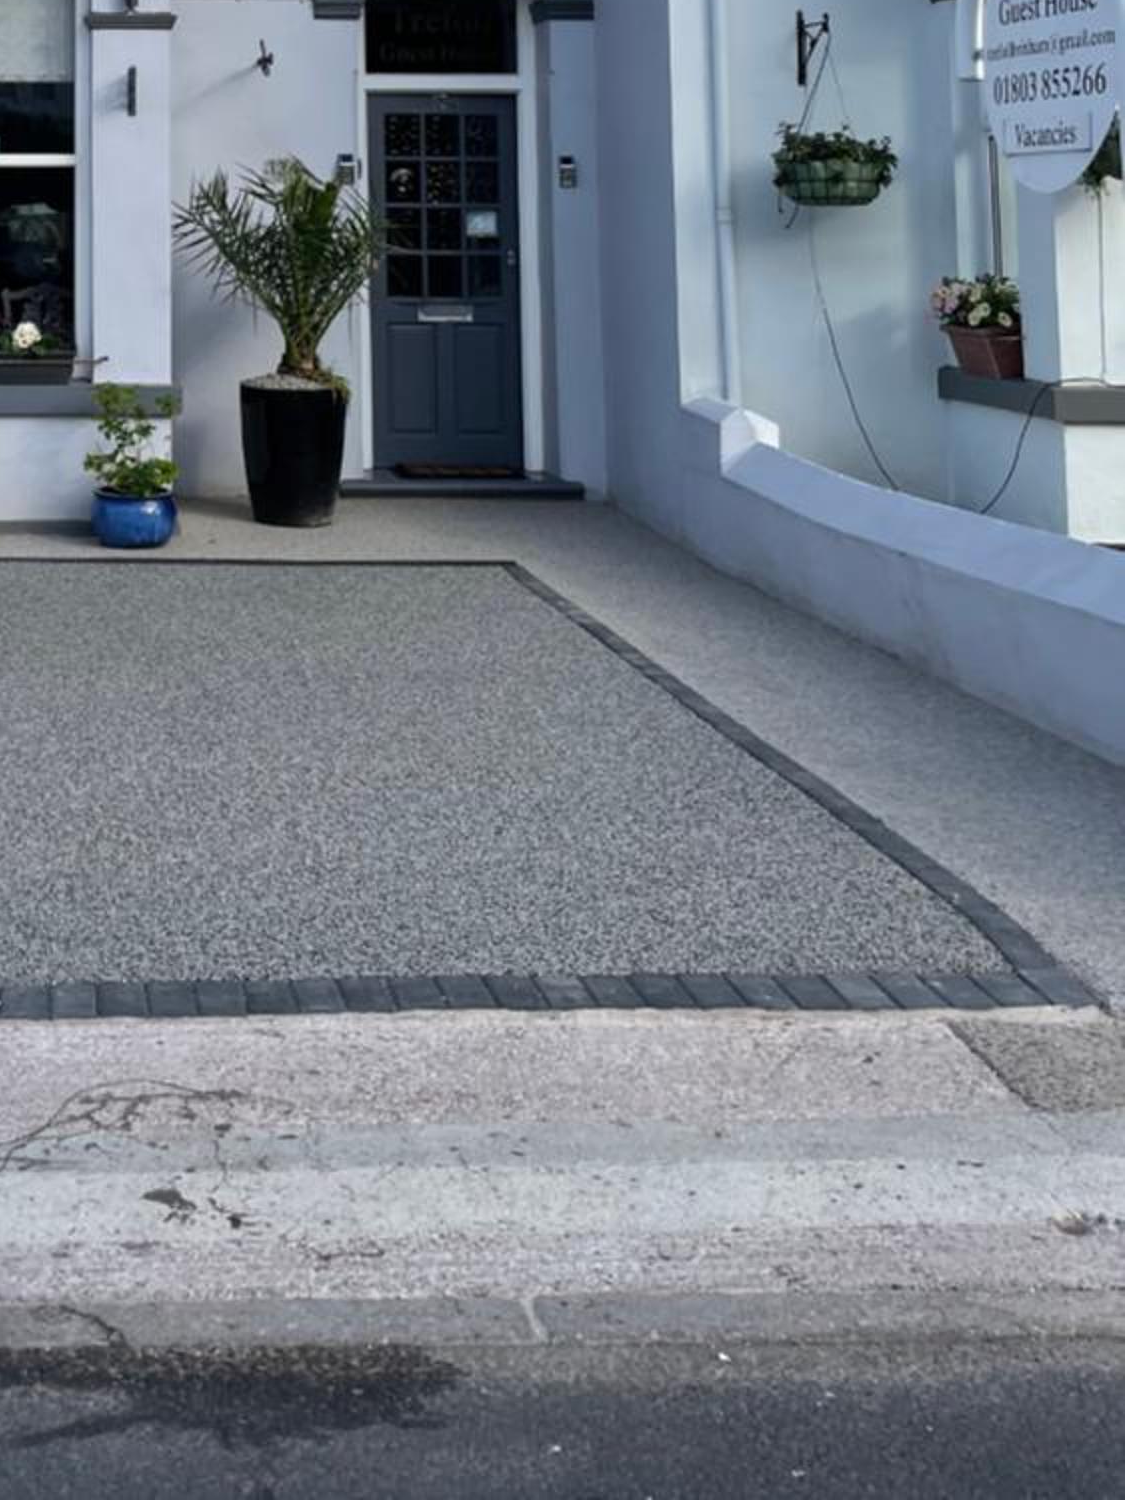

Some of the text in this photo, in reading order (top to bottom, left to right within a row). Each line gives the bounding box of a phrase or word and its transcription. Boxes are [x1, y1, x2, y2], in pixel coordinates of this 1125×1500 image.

[992, 62, 1107, 106] 01803 855266
[1014, 119, 1078, 148] Vacancies
